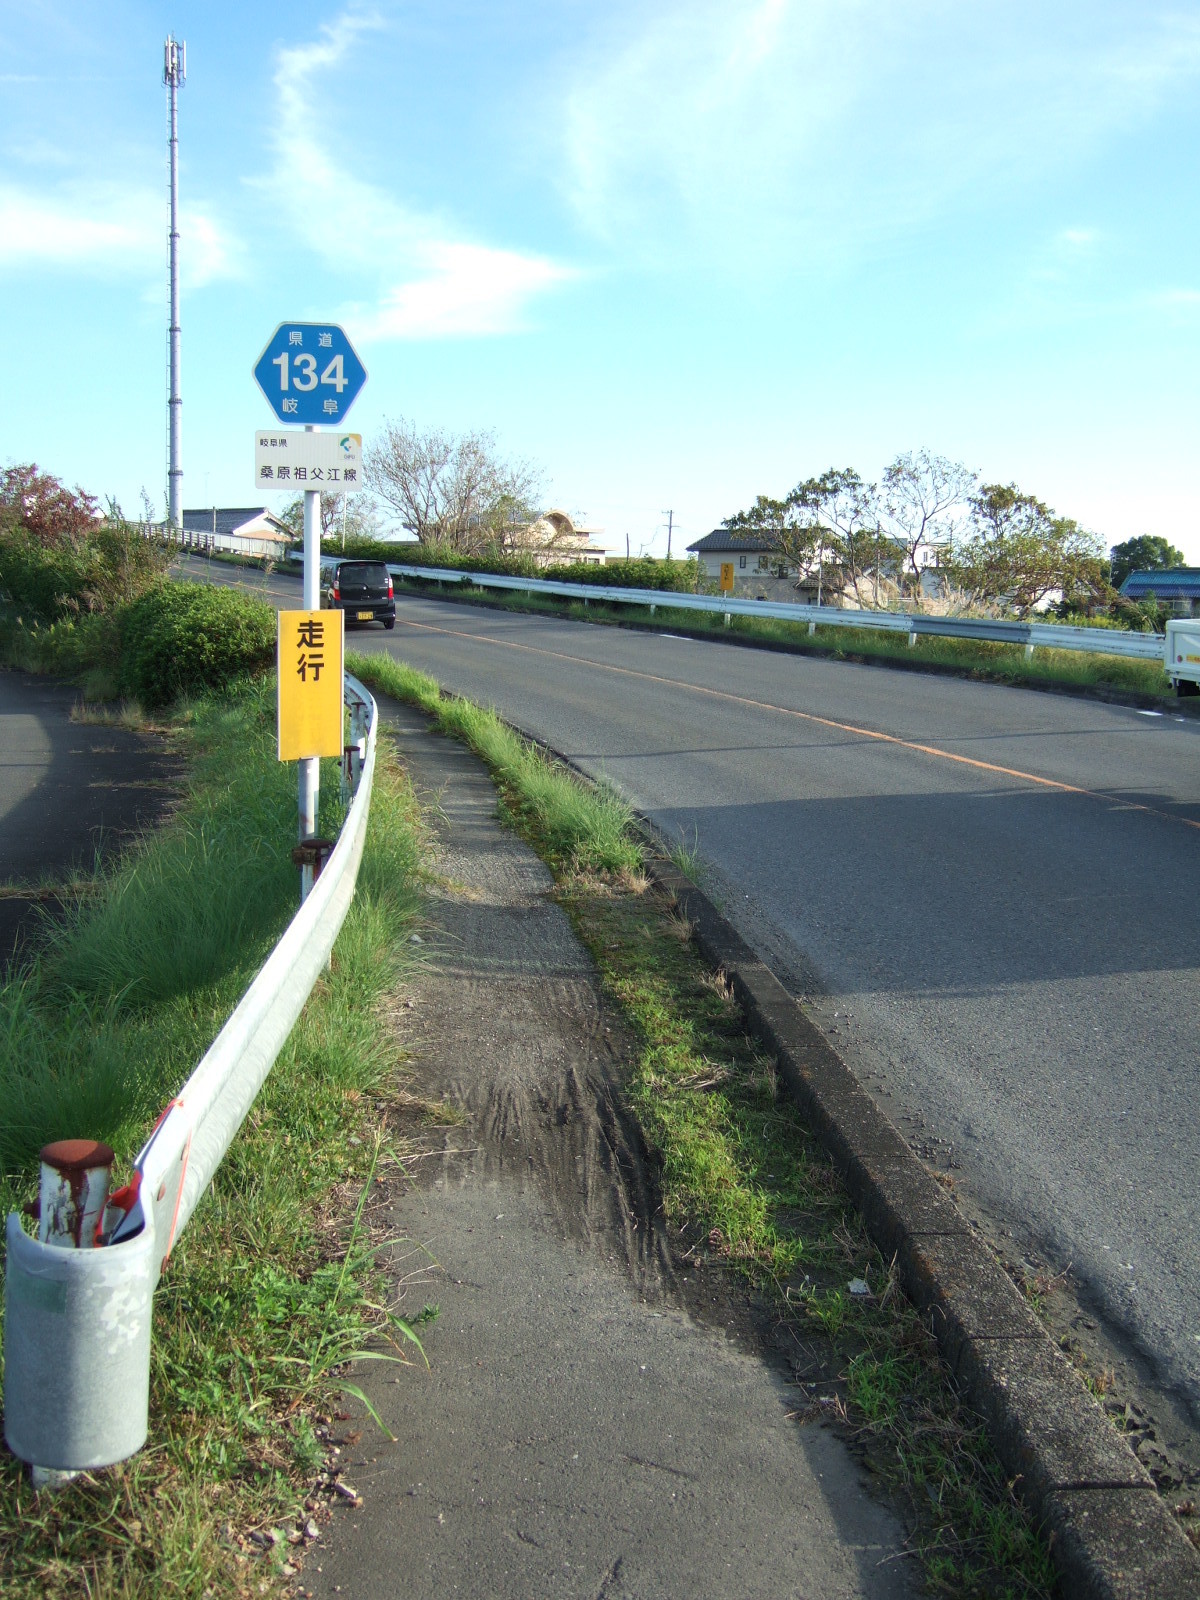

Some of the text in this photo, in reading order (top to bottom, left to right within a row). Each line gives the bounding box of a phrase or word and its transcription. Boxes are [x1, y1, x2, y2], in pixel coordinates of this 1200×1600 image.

[289, 331, 333, 347] 県道
[272, 352, 348, 393] 134
[282, 398, 339, 415] 岐阜
[260, 438, 288, 448] 岐阜県
[260, 465, 357, 482] 桑原祖父江線
[297, 620, 325, 682] 走行
